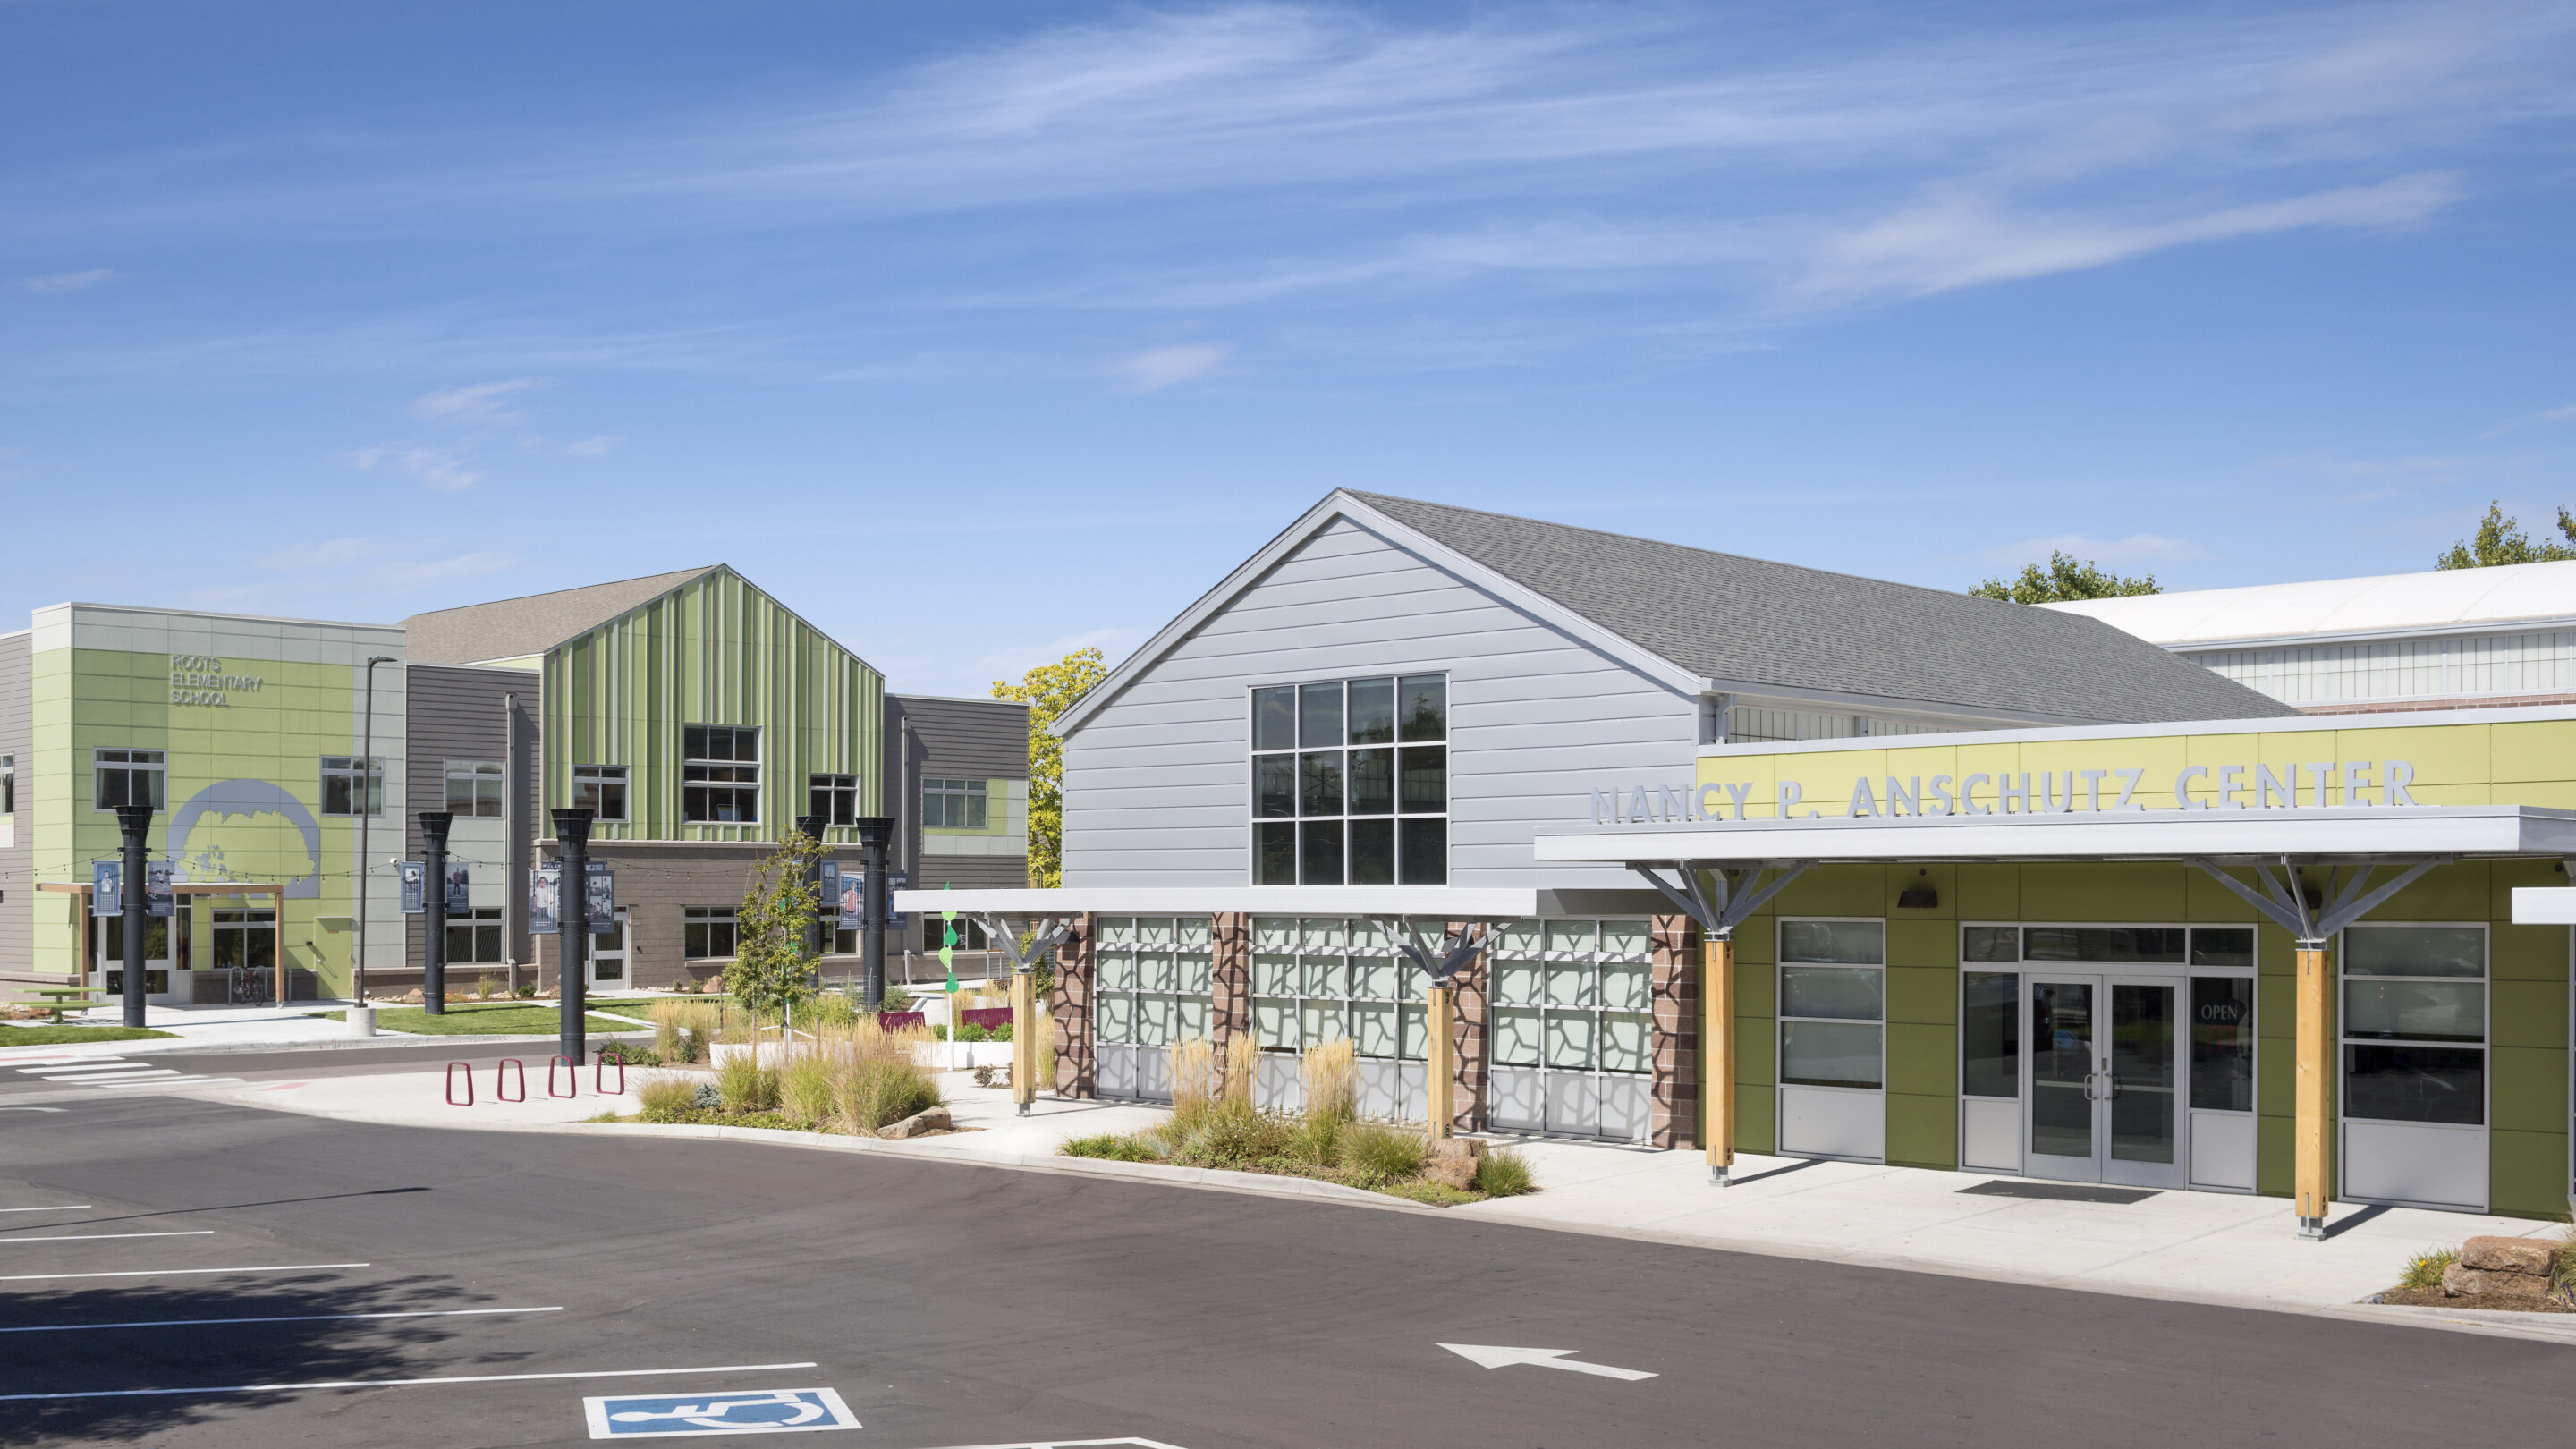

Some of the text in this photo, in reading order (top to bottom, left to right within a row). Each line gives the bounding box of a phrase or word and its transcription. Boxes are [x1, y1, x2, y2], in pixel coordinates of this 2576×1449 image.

[172, 655, 222, 671] ROOTS
[172, 673, 261, 690] ELEMENTARY
[172, 690, 229, 706] SCHOOL
[1591, 760, 2419, 825] NANCY P. ANSCHUTZ CENTER
[2201, 1004, 2237, 1020] OPEN
